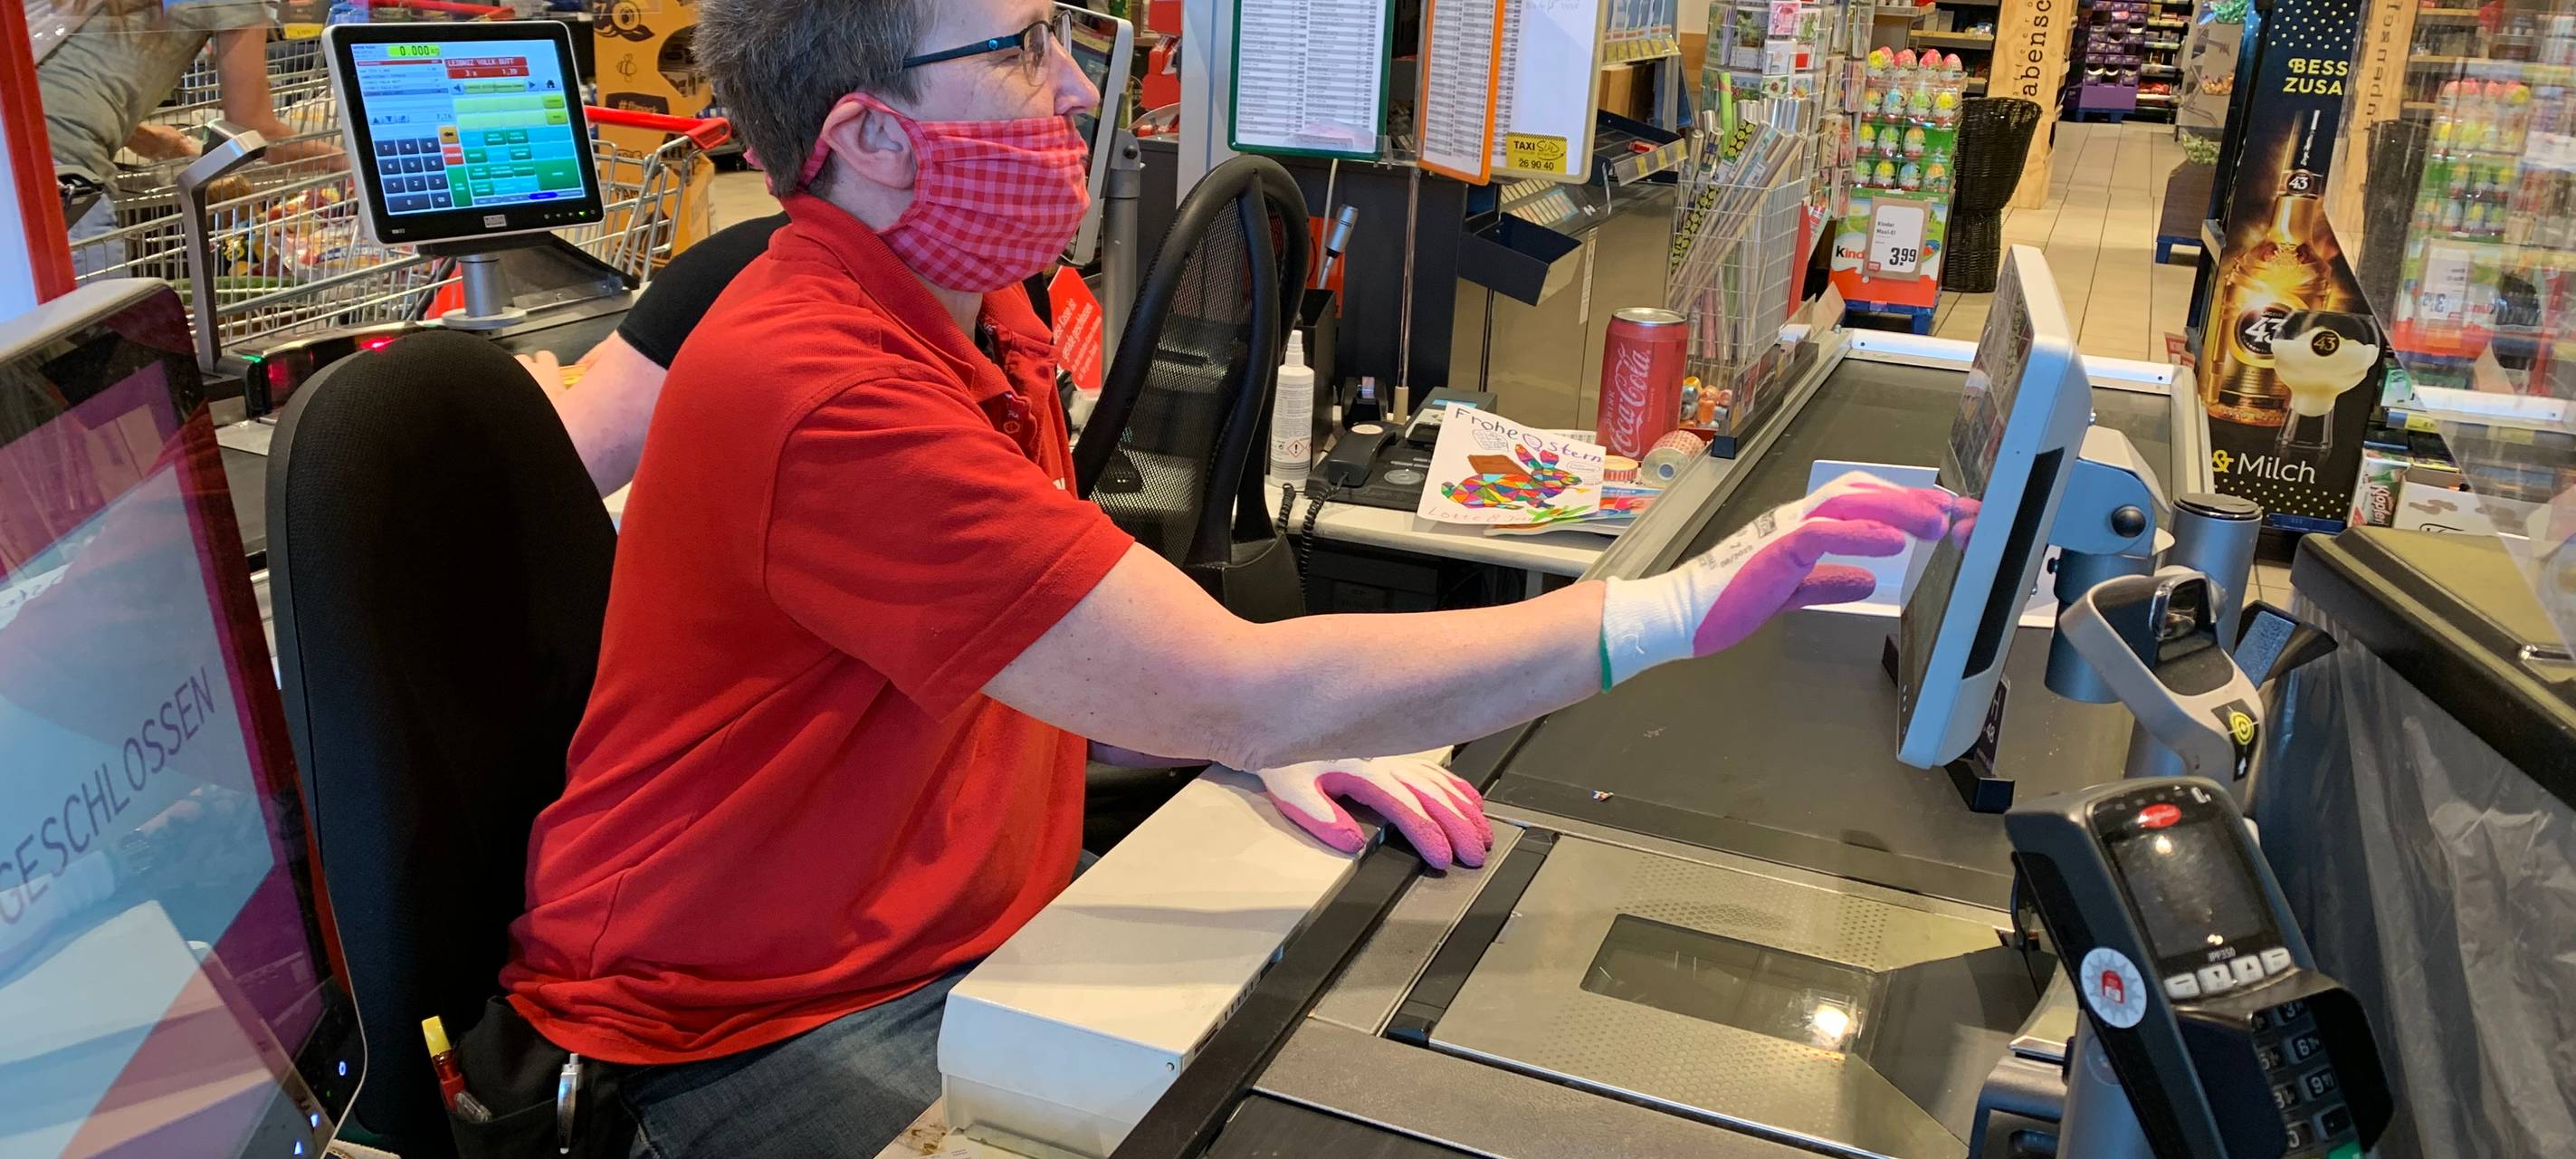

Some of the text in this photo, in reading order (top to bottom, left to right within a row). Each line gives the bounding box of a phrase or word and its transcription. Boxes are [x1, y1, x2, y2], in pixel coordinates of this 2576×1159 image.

[399, 45, 430, 56] 0.000
[2288, 58, 2349, 76] BESS
[2283, 77, 2343, 96] ZUSA
[1513, 140, 1535, 151] TAXI
[1519, 158, 1555, 171] 26 90 40
[2289, 175, 2310, 190] 43
[1889, 247, 1917, 266] 3.99
[2314, 336, 2337, 351] 43
[1455, 407, 1518, 442] Frohe
[2212, 449, 2315, 484] & Milch
[2371, 484, 2392, 525] Klopfer
[0, 666, 215, 925] GESCHLOSSEN
